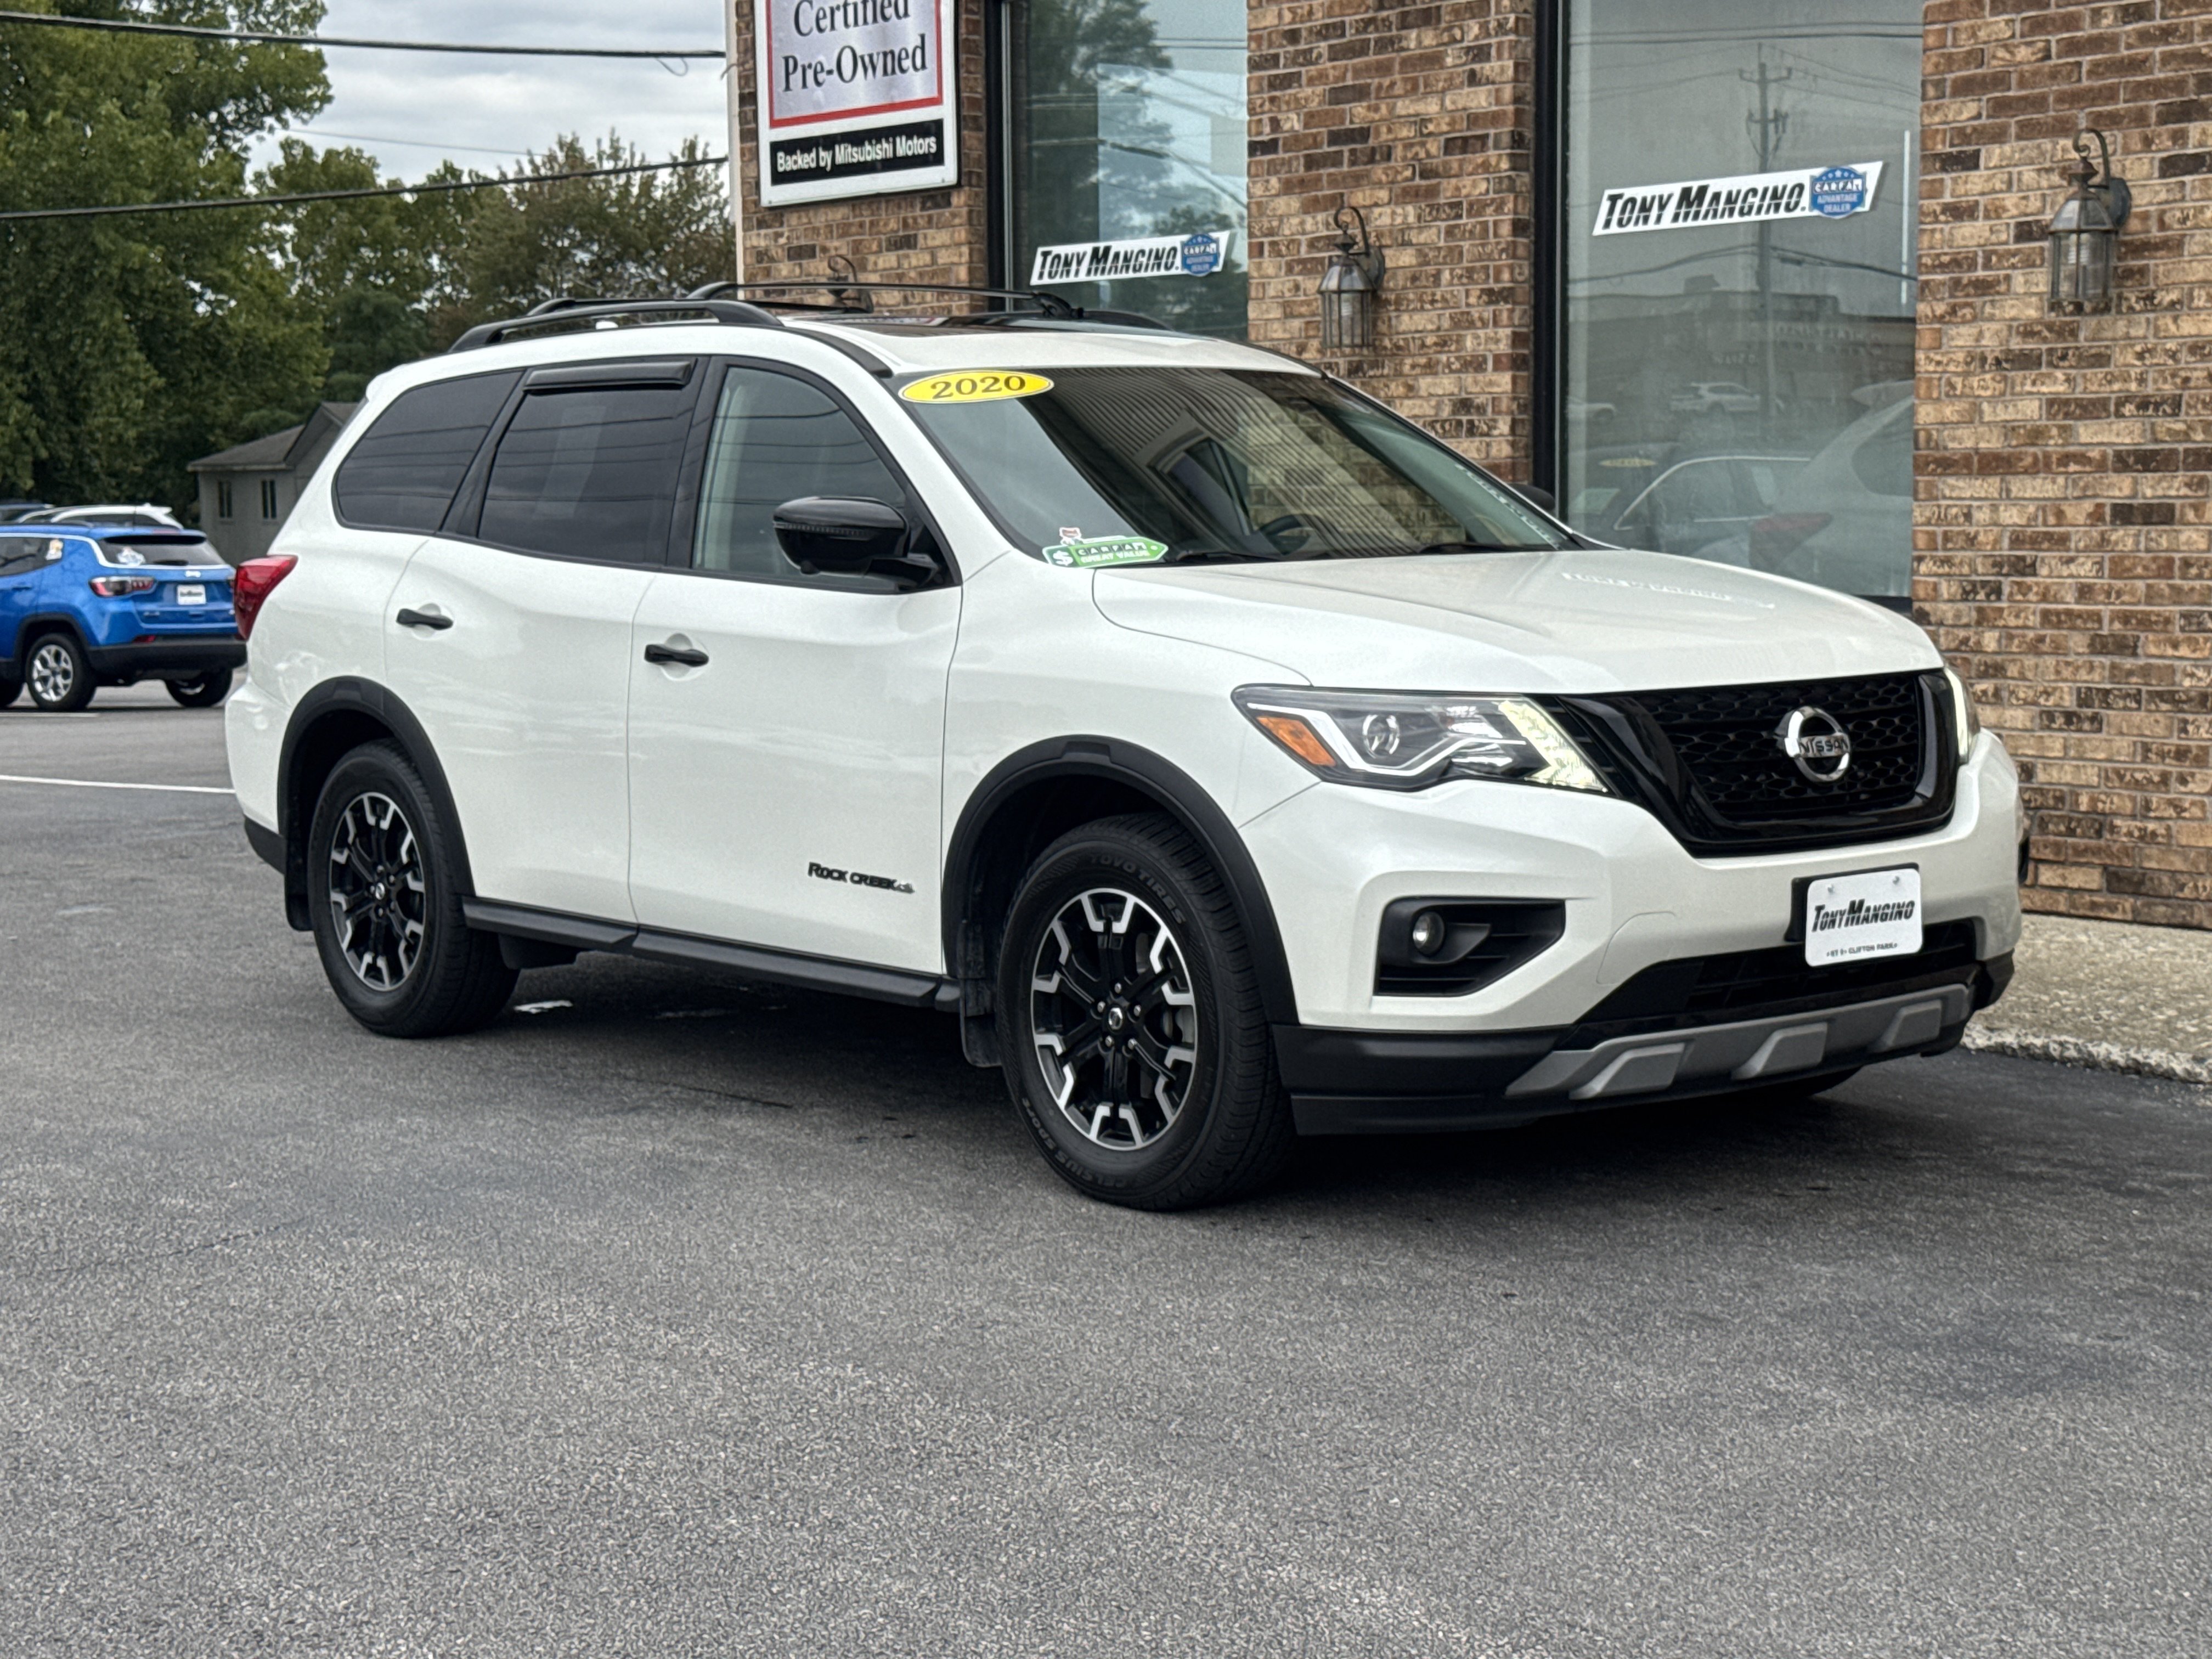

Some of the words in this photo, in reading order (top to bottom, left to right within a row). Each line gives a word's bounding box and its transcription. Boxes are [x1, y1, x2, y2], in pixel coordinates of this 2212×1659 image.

[782, 33, 928, 92] Pre-Owned
[776, 147, 816, 172] Backed
[818, 146, 833, 172] by
[834, 136, 894, 165] Mitsubishi
[895, 135, 937, 157] Motors
[1601, 192, 1675, 230] TONY
[1037, 250, 1087, 281] TONY
[930, 375, 1026, 399] 2020
[1799, 737, 1849, 753] NISSAN
[808, 862, 849, 883] ROCK
[850, 872, 898, 891] CREEK
[1137, 868, 1187, 925] TIRES
